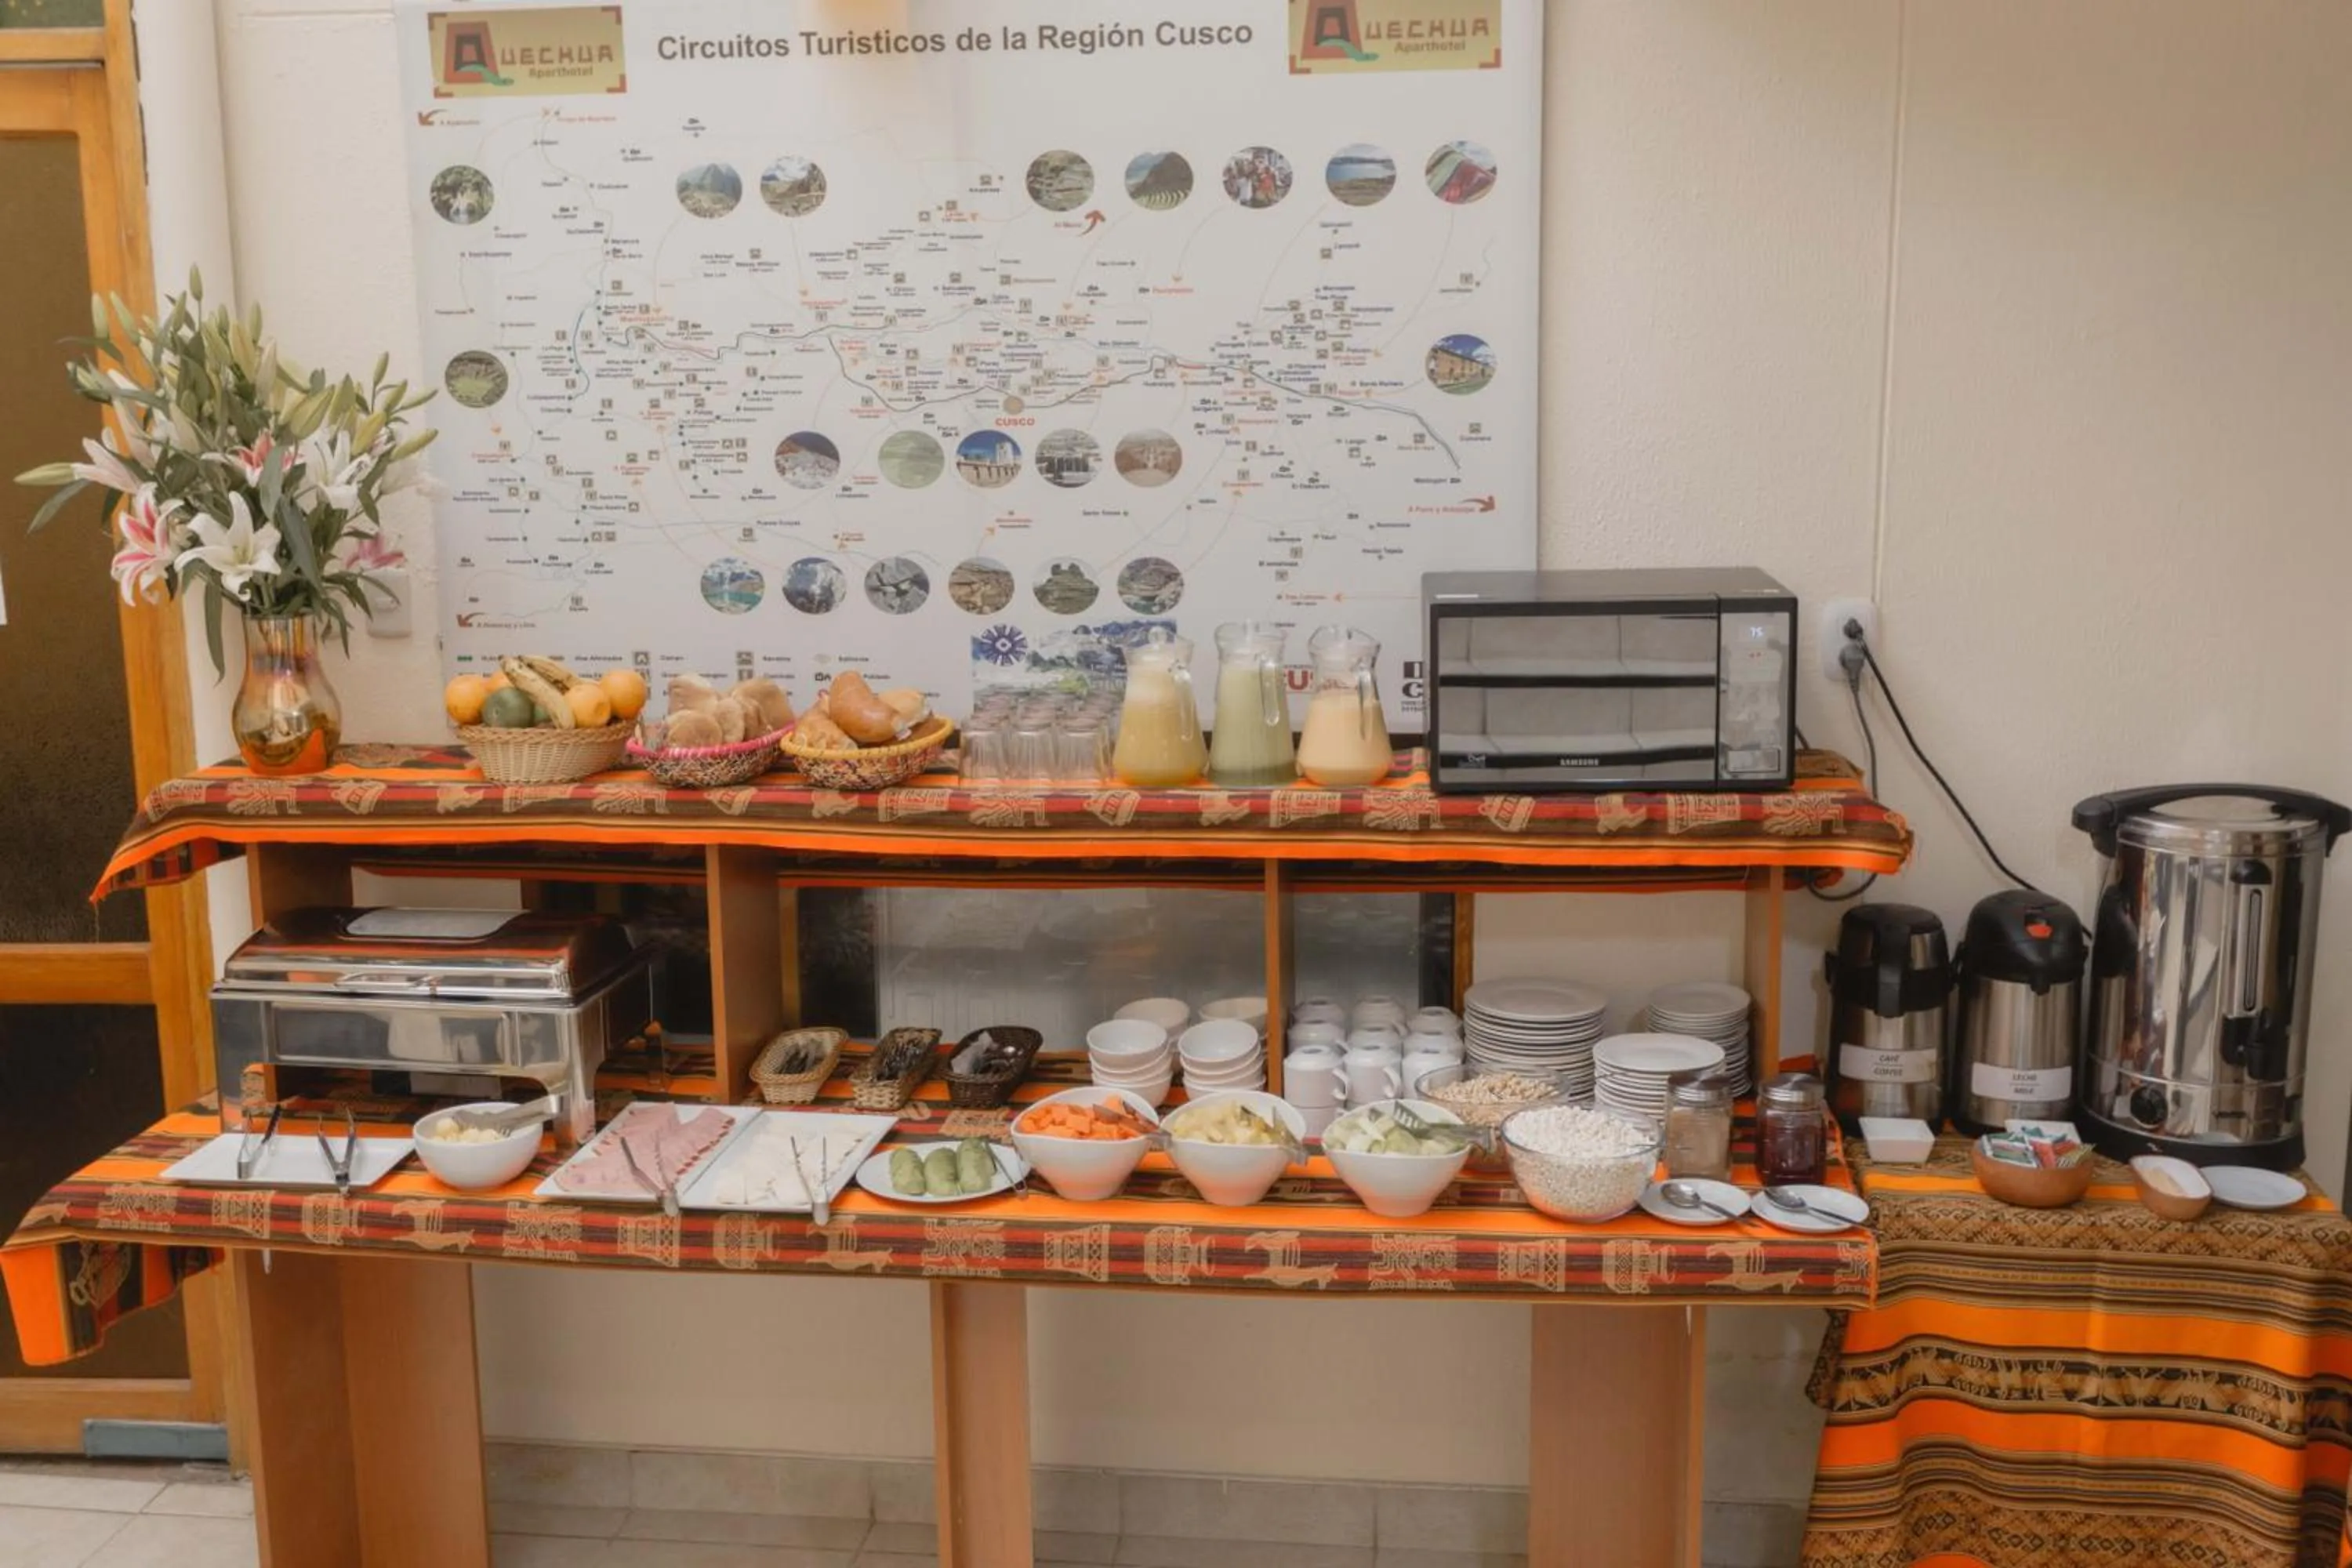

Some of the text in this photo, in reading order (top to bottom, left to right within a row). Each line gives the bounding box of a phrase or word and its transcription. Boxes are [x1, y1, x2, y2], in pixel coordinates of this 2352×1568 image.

[657, 21, 1254, 60] Circuitos Turisticos de la Región Cusco
[1394, 40, 1465, 53] Aparthotel
[528, 66, 593, 79] Aparthotel
[995, 417, 1035, 426] CUSCO
